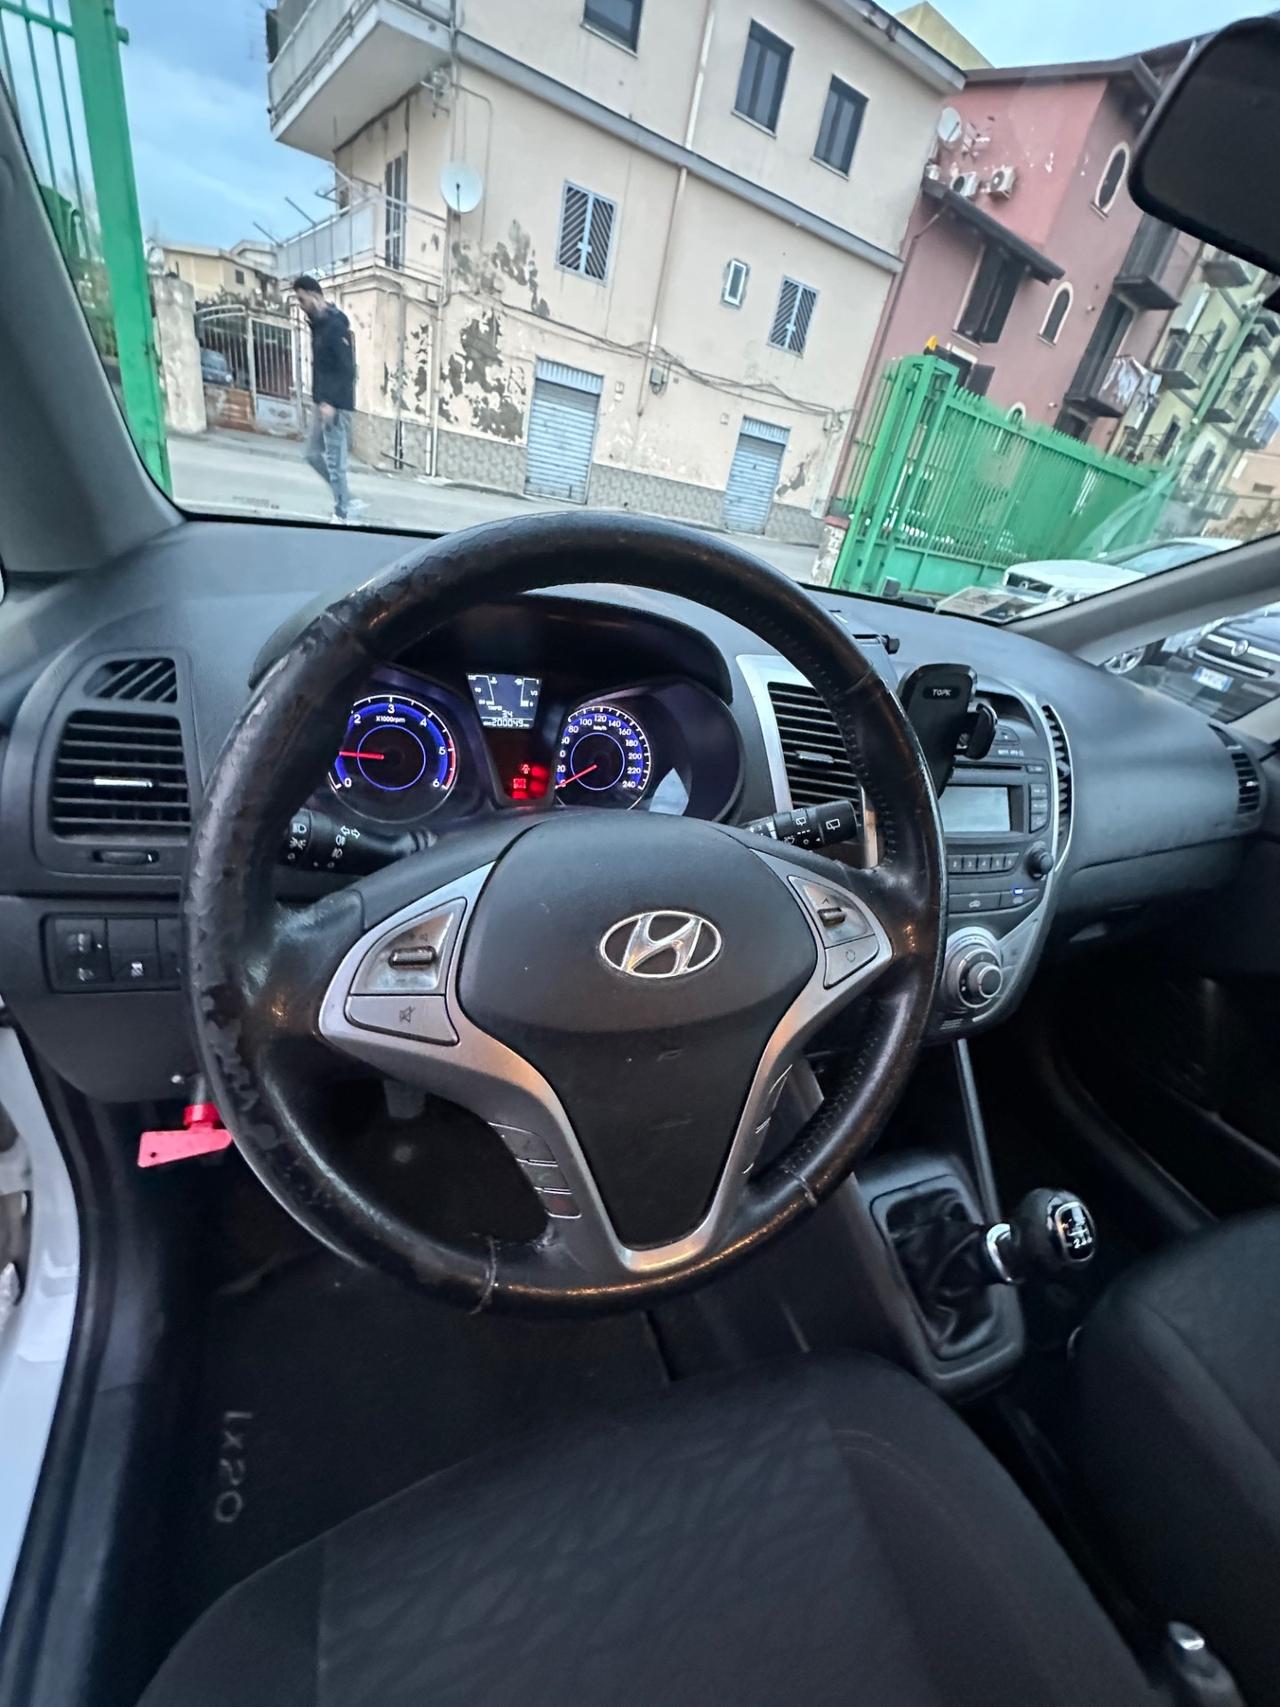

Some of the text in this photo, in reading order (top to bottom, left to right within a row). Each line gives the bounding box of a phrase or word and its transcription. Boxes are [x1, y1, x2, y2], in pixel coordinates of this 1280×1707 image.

[932, 688, 952, 697] TOPK
[388, 704, 395, 714] 3
[354, 714, 361, 724] 2
[420, 718, 427, 727] 4
[492, 718, 524, 728] 200049
[579, 718, 593, 726] 100
[594, 715, 607, 723] 120
[567, 725, 579, 733] 80
[619, 728, 632, 736] 160
[438, 746, 446, 756] 5
[628, 752, 642, 760] 200
[627, 767, 641, 775] 220
[344, 777, 352, 788] 0
[433, 779, 440, 788] 6
[622, 781, 636, 789] 240
[1073, 1238, 1081, 1249] 2
